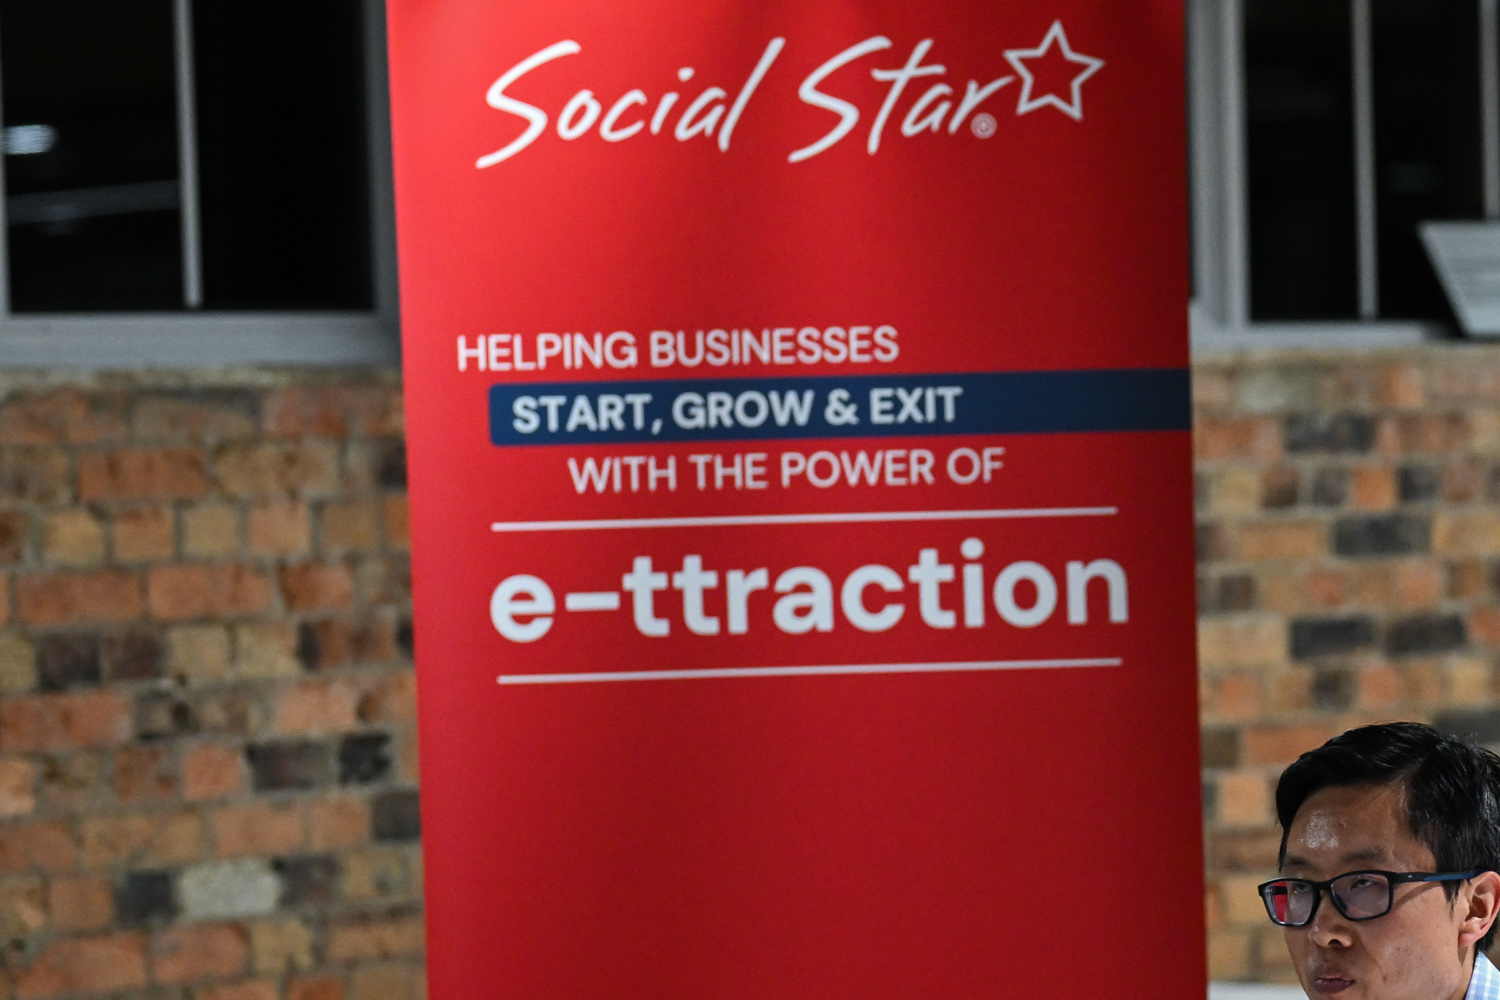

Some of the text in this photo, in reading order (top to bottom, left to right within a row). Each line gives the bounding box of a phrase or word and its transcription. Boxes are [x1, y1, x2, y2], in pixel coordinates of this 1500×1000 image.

[475, 38, 785, 169] Social
[456, 325, 899, 373] HELPING BUSINESSES
[512, 386, 963, 435] START, GROW & EXIT
[567, 447, 1004, 494] WITH THE POWER OF
